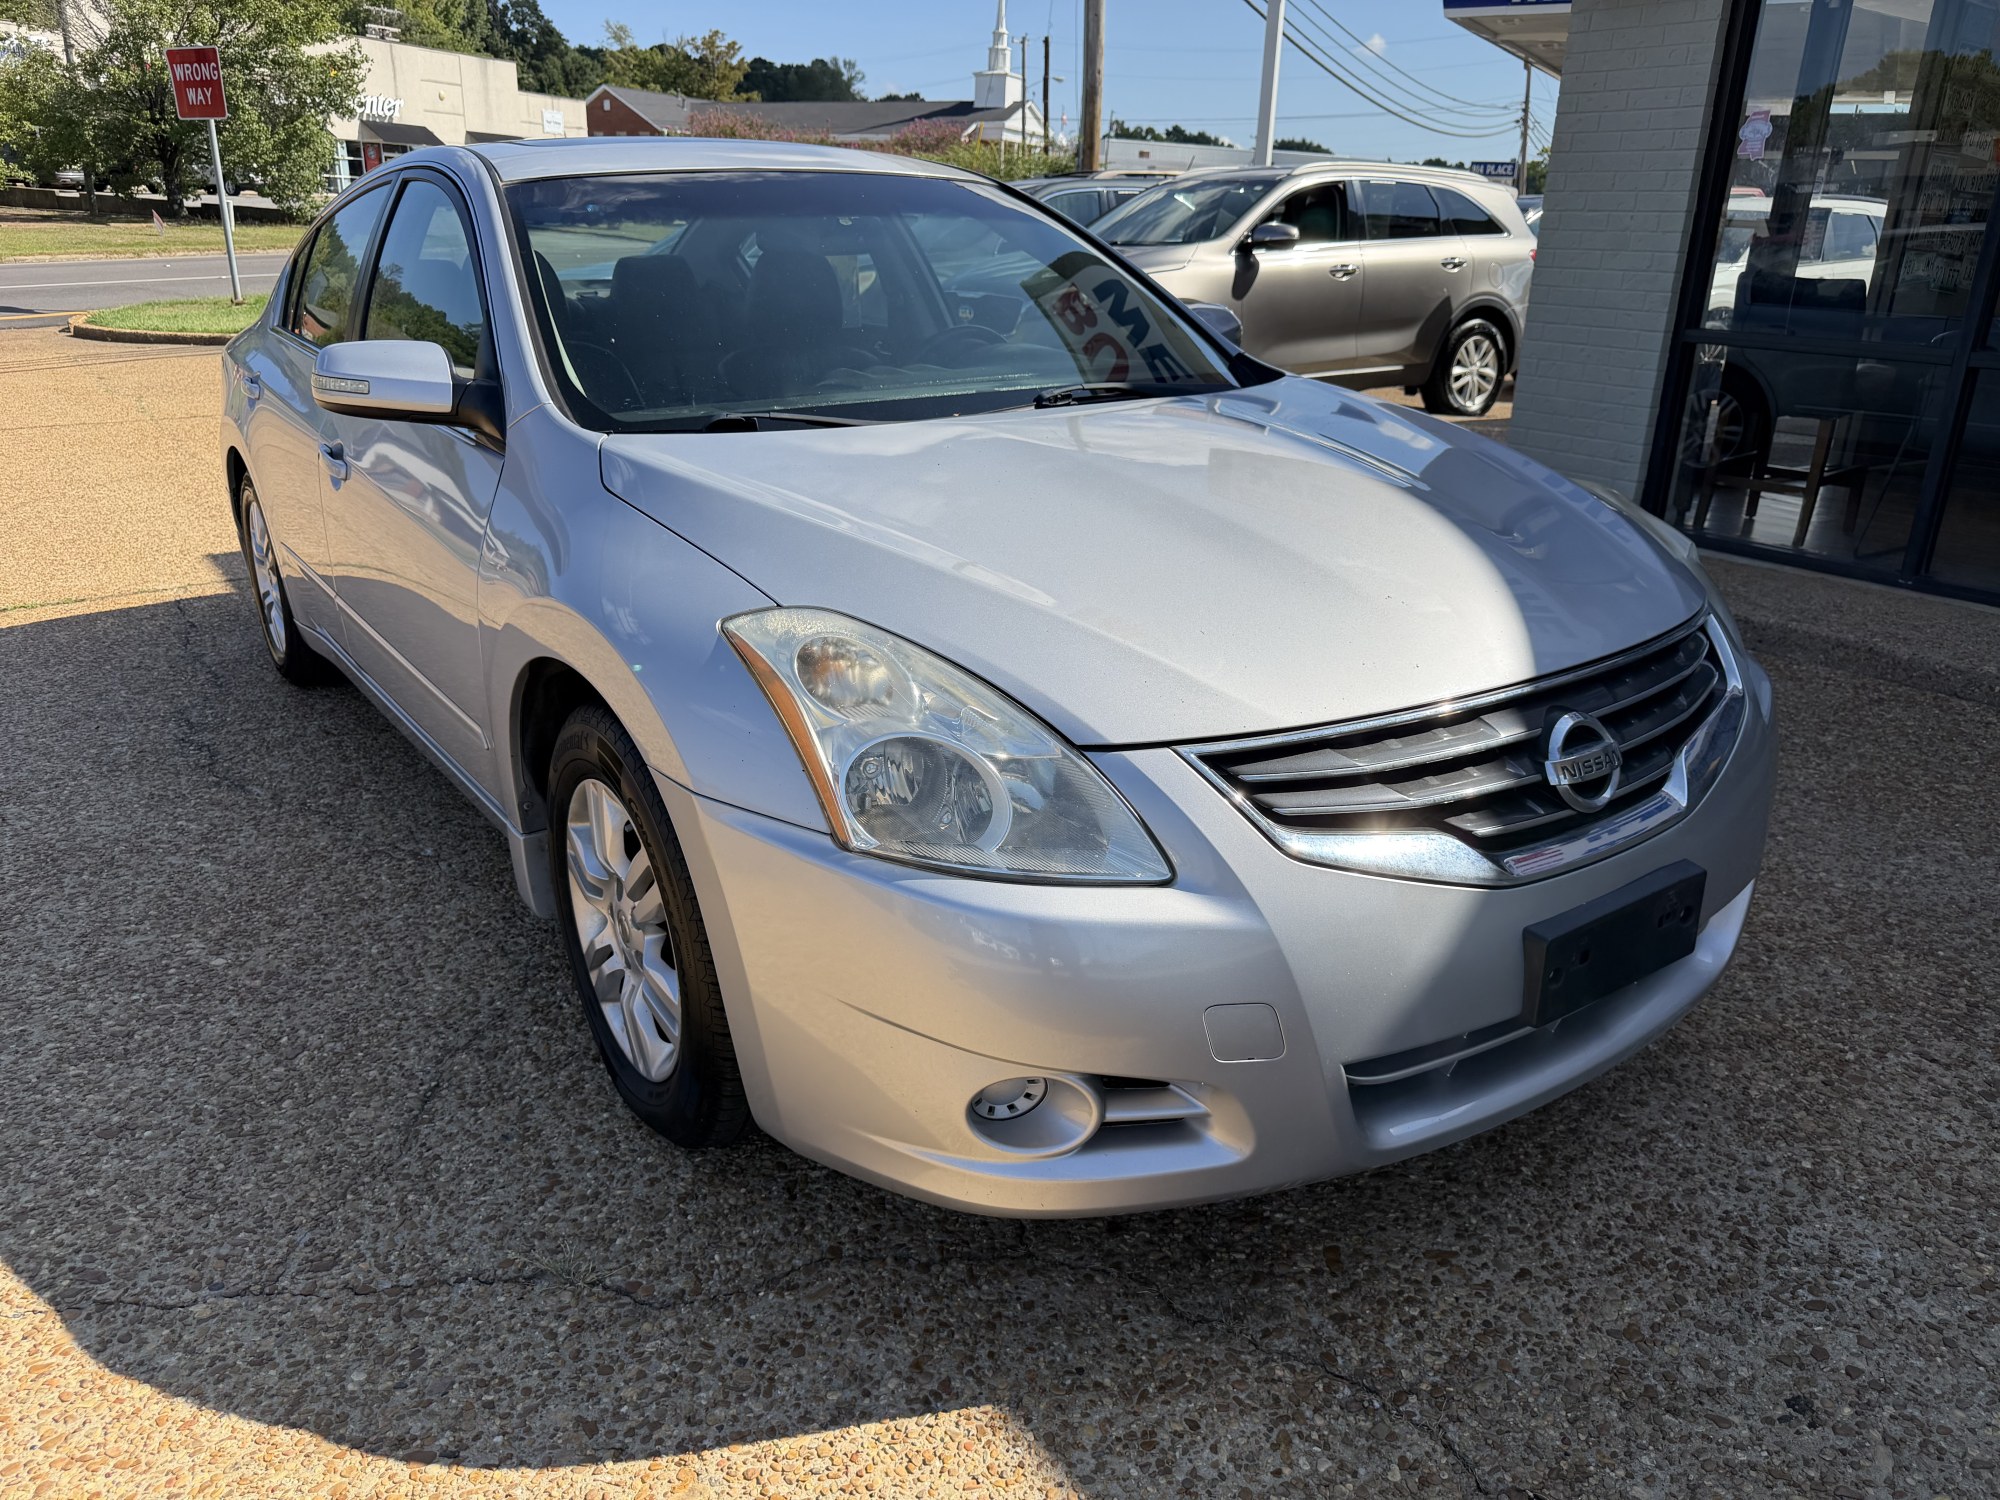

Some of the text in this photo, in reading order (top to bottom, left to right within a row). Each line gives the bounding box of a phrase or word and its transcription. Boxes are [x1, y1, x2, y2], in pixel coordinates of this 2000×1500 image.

[173, 62, 218, 81] WRONG
[186, 87, 212, 105] WAY
[354, 93, 405, 117] enter
[1485, 164, 1514, 175] PLACE
[1560, 750, 1620, 780] NISSAN
